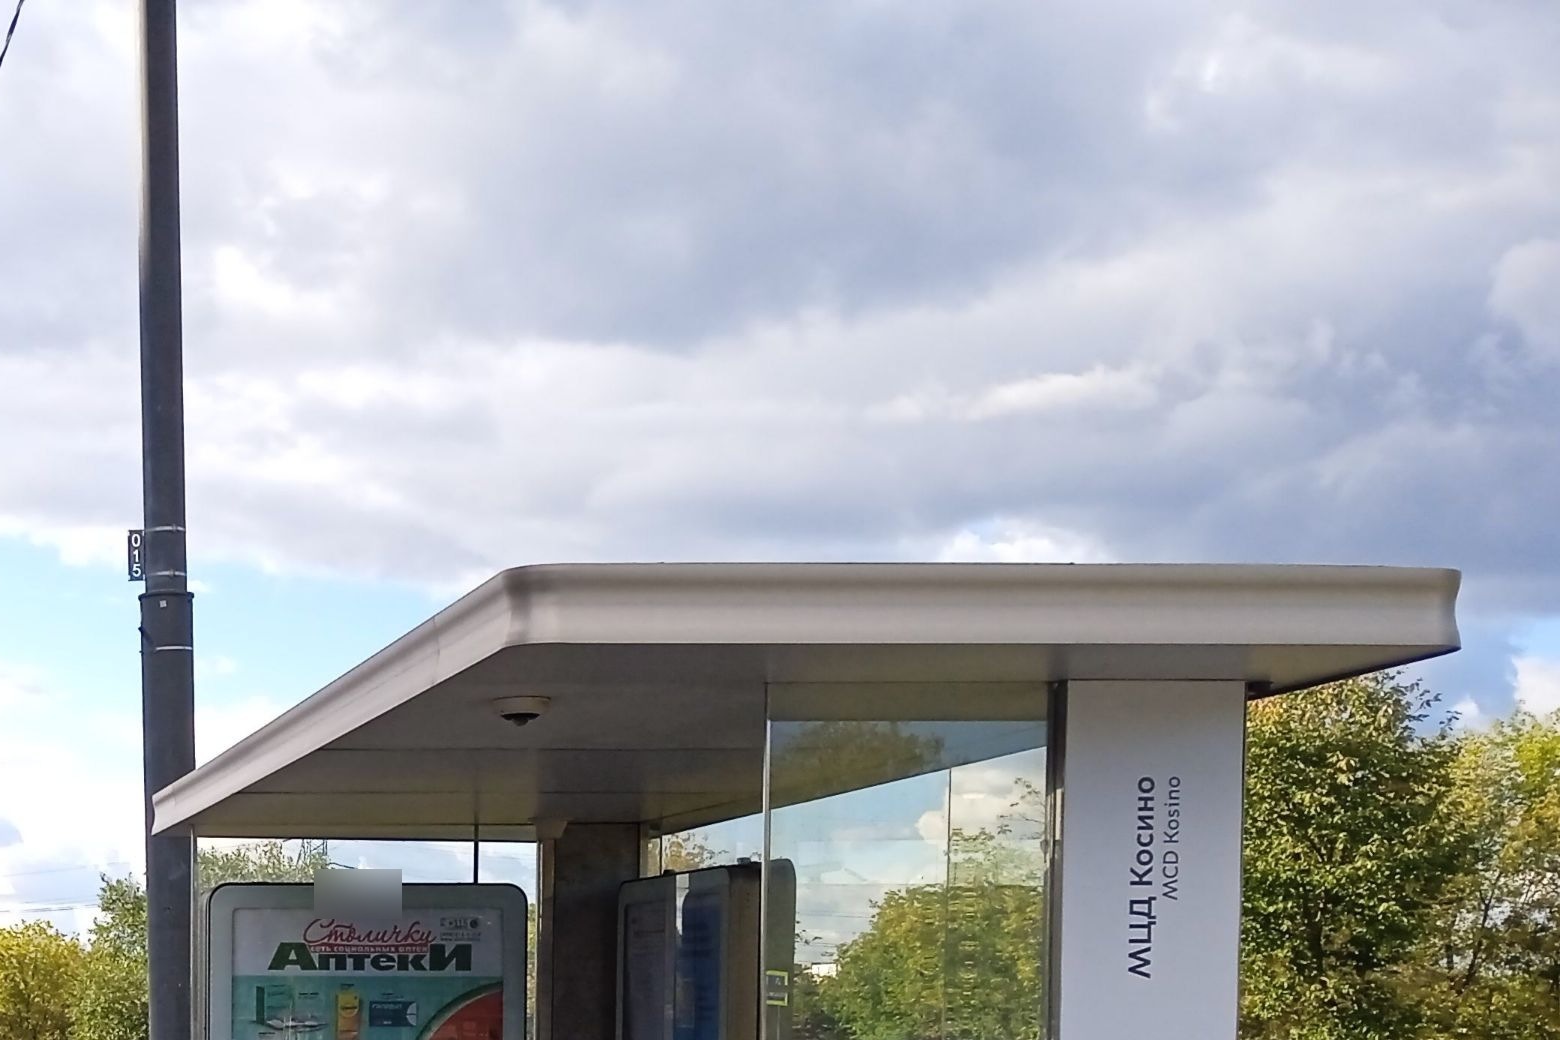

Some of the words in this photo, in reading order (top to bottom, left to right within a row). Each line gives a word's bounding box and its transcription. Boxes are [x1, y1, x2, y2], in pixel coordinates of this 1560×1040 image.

[1129, 776, 1155, 886] Косино
[1163, 776, 1181, 844] Kosino
[1162, 850, 1178, 900] MCD
[303, 918, 437, 943] Столички
[1127, 896, 1157, 979] МЦД
